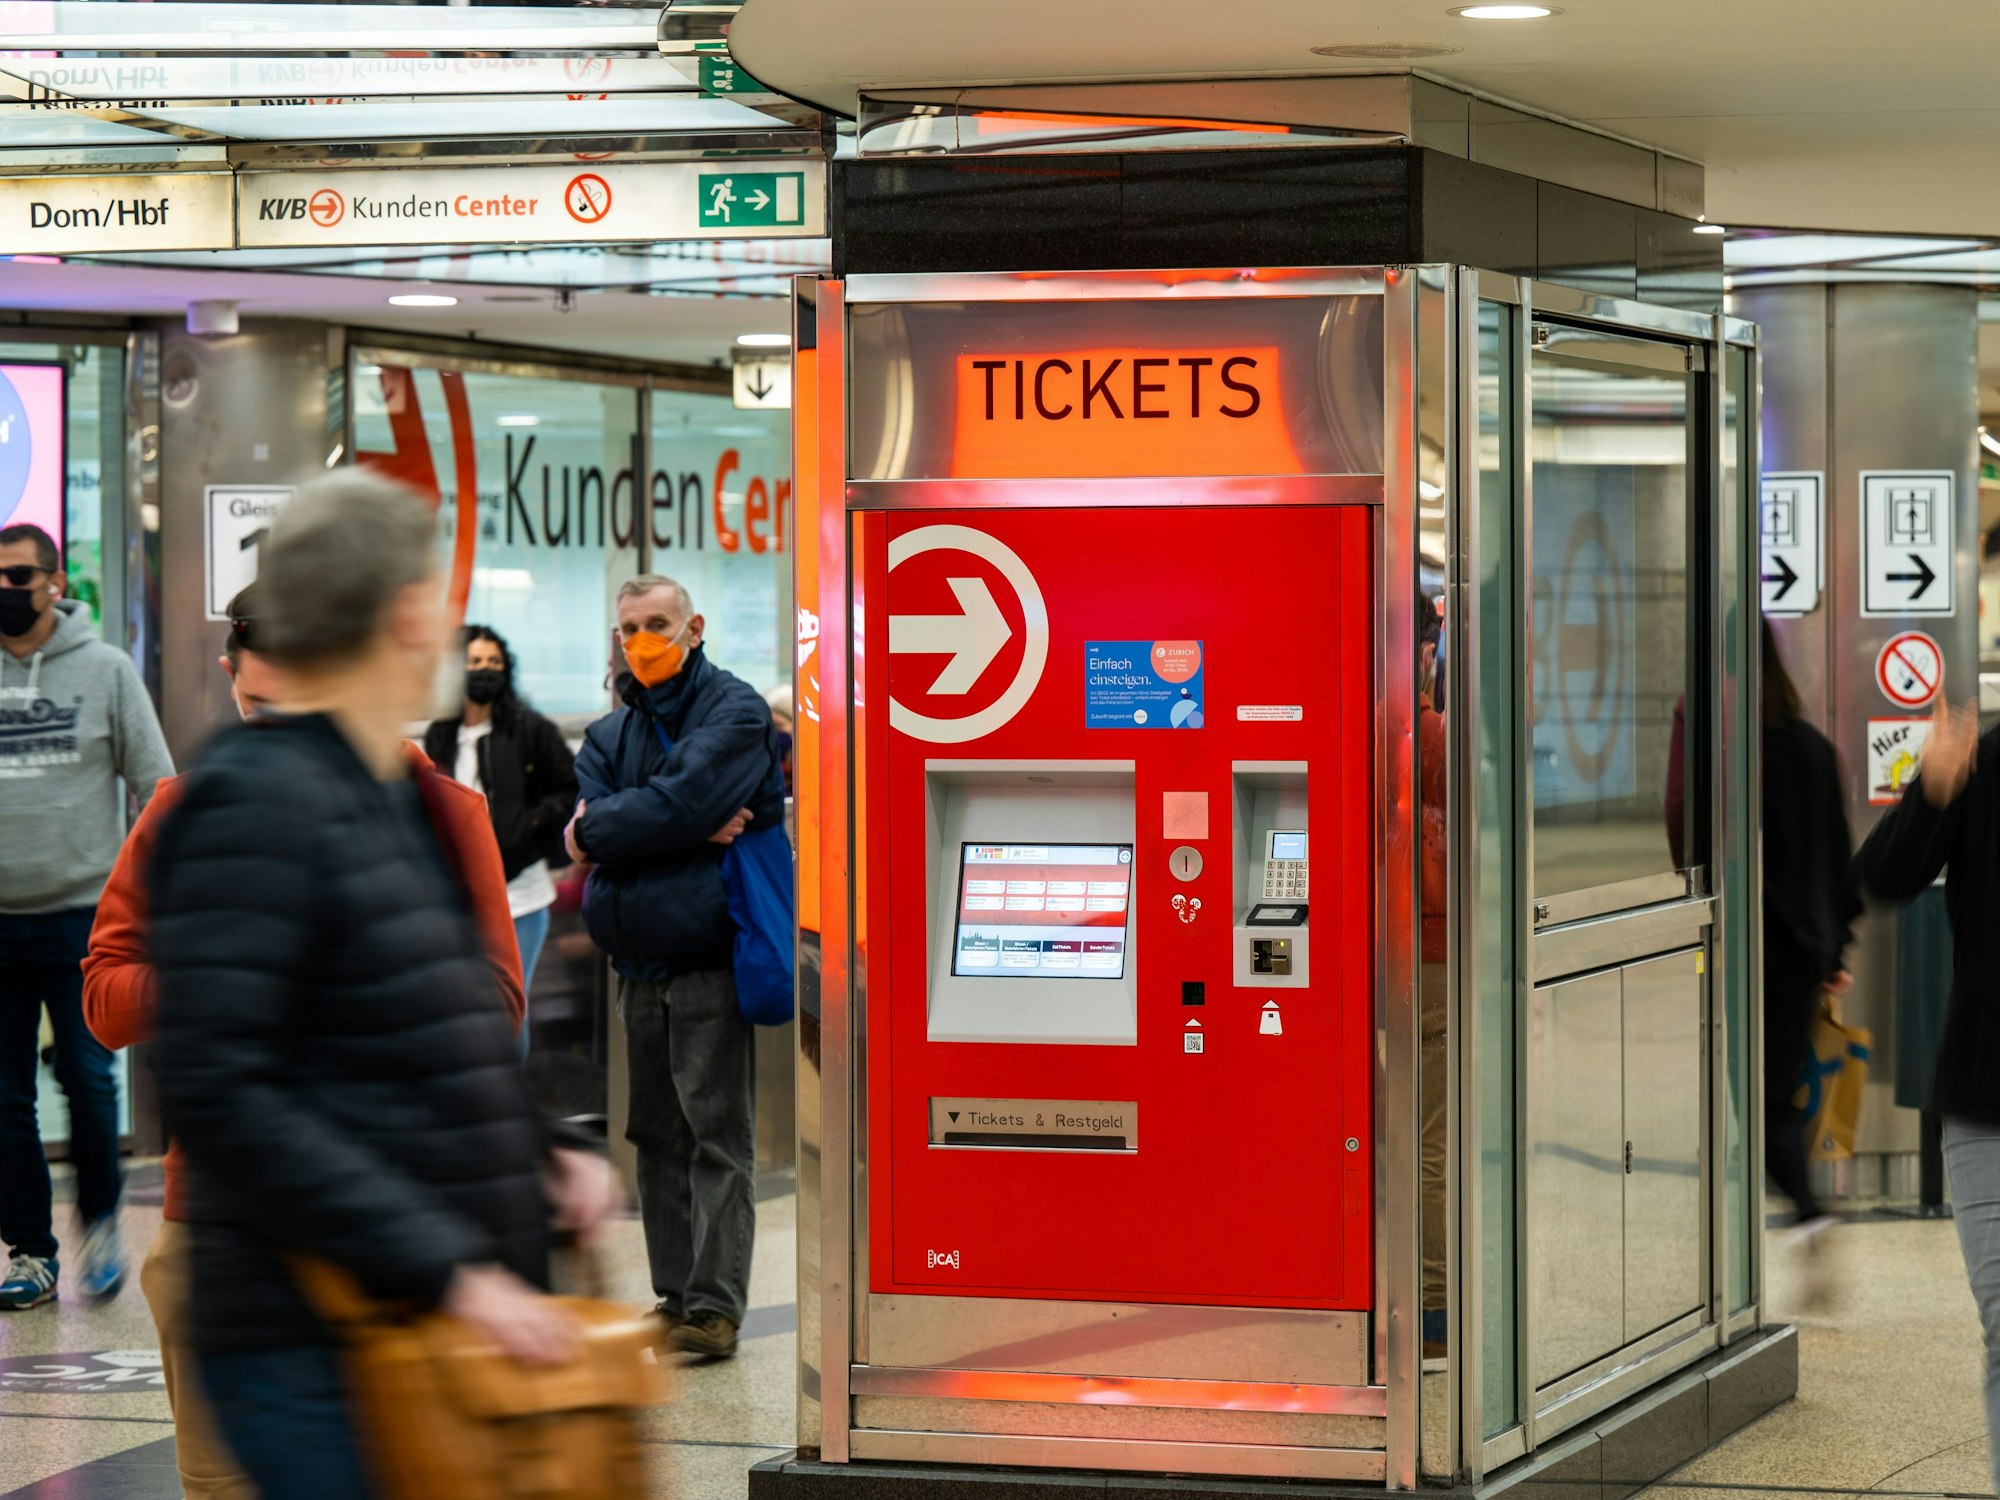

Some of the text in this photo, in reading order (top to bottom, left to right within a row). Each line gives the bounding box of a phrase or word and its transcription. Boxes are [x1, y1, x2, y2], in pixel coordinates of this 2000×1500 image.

[30, 198, 169, 228] Dom/Hbf
[259, 194, 539, 220] KVB Kunden Center
[972, 356, 1260, 421] TICKETS
[1090, 658, 1132, 670] Einfach
[1090, 674, 1152, 689] einsteigen.
[1872, 726, 1910, 756] Hier
[968, 1112, 1123, 1131] Tickets & Restgeld
[933, 1253, 954, 1265] ICA
